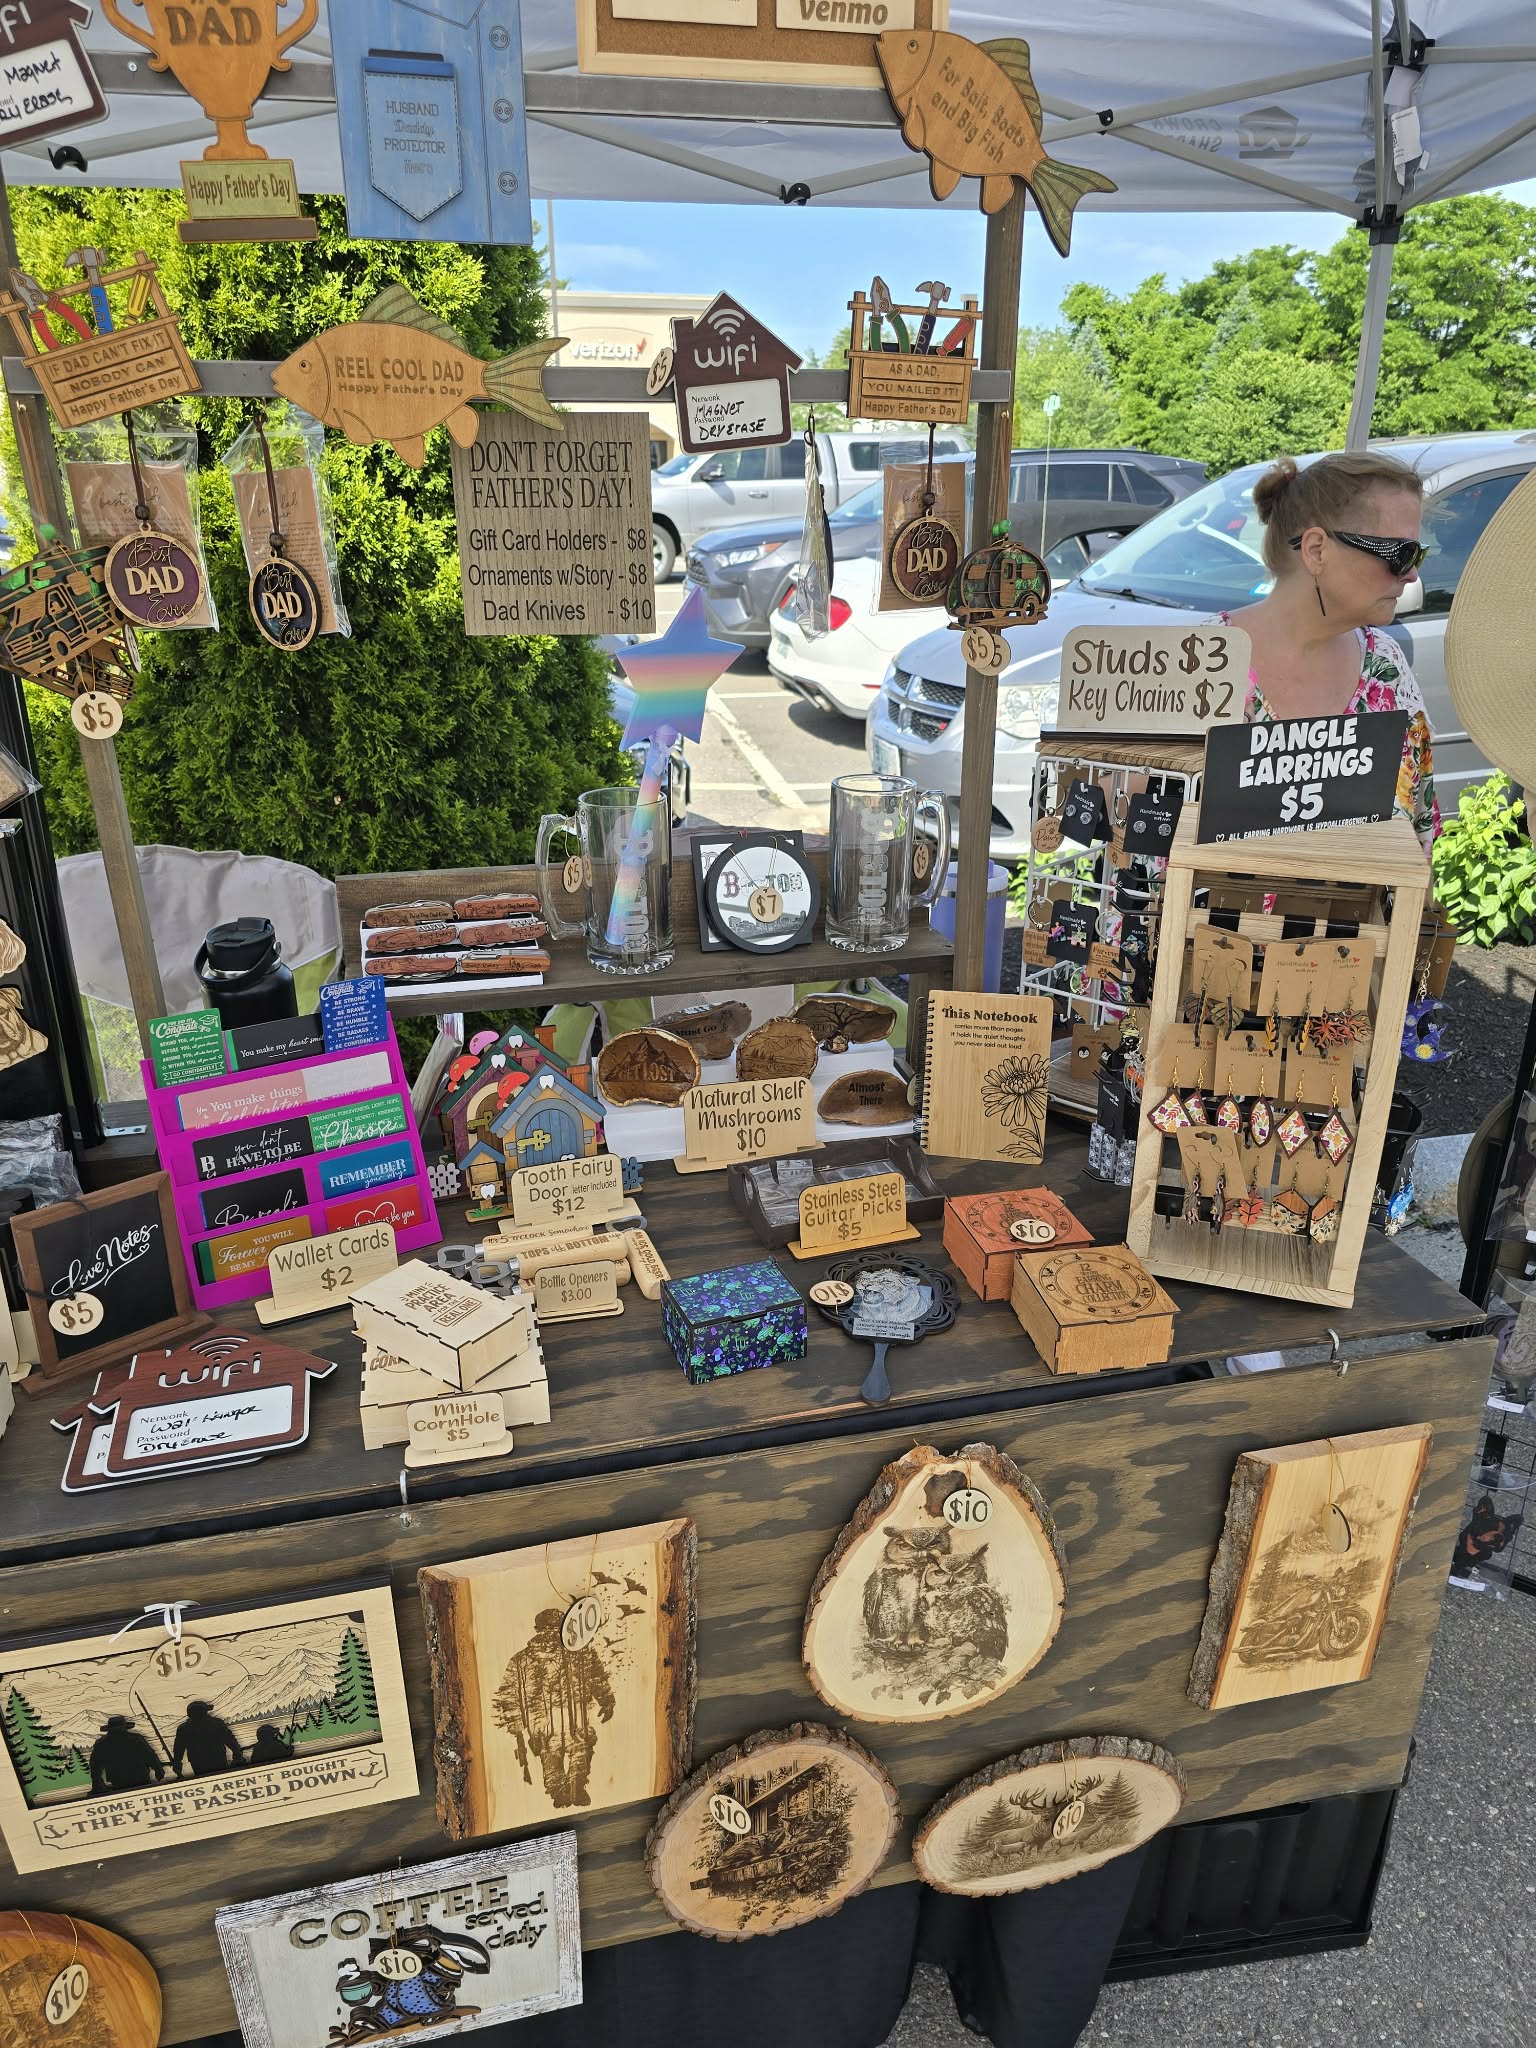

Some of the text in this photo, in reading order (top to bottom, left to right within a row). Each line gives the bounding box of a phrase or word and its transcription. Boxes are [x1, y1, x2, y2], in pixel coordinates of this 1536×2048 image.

[165, 7, 262, 46] DAD
[386, 100, 440, 117] HUSBAND
[937, 56, 1026, 148] For Bait, Boats
[930, 91, 1006, 163] and Big Fish
[384, 137, 446, 154] PROTECTOR
[188, 173, 291, 206] Happy Father's Day
[64, 335, 151, 374] DAD CAN'T FIX
[570, 341, 640, 361] verizon
[69, 356, 167, 393] NOBODY CAN
[335, 356, 464, 382] REEL COOL DAD
[651, 356, 668, 389] $5
[70, 375, 181, 417] Happy Father's Day
[338, 383, 464, 397] Happy Father's Day
[868, 382, 940, 395] YOU NAILED
[865, 400, 957, 417] Happy Father's Day
[470, 441, 633, 473] DON'T FORGET
[472, 477, 634, 508] FATHER'S DAY!
[470, 527, 647, 553] Gift Card Holders $8
[907, 547, 948, 573] DAD
[125, 566, 184, 595] DAD
[468, 562, 647, 591] Ornaments w/Story $8
[262, 591, 303, 619] DAD
[483, 597, 652, 623] Dad Knives $10
[967, 635, 989, 661] $5
[1072, 633, 1230, 676] Studs $3
[1068, 678, 1235, 722] Key Chains $2
[81, 703, 113, 733] $5
[1250, 717, 1359, 756] DANGLE
[1279, 782, 1325, 822] $5
[1228, 831, 1241, 842] ALL
[1272, 825, 1305, 836] HARDWARE
[567, 863, 580, 889] $5
[916, 851, 927, 875] $5
[756, 895, 777, 917] $7
[942, 1005, 1038, 1023] This Notebook
[156, 1019, 199, 1039] Congrats
[240, 1036, 309, 1057] You make my heart
[210, 1085, 304, 1113] You make things
[691, 1080, 806, 1110] Natural Shelf
[848, 1081, 885, 1093] Almost
[858, 1095, 884, 1106] There
[698, 1106, 801, 1130] Mushrooms
[737, 1127, 766, 1151] $10
[226, 1151, 264, 1169] HAVE
[283, 1142, 302, 1156] BE
[330, 1158, 406, 1187] REMEMBER
[518, 1159, 613, 1186] Tooth Fairy
[529, 1178, 617, 1203] Door letter included
[804, 1177, 901, 1211] Stainless Steel
[552, 1196, 585, 1216] $12
[805, 1198, 902, 1227] Guitar Picks
[253, 1229, 294, 1246] YOU WILL
[838, 1222, 862, 1241] $5
[1016, 1224, 1051, 1239] $10
[51, 1224, 158, 1296] Love Notes
[217, 1244, 267, 1265] Forever
[275, 1229, 390, 1273] Wallet Cards
[520, 1235, 609, 1260] TOPS BOTTOM
[321, 1265, 354, 1292] $2
[540, 1271, 609, 1289] Bottle Openers
[1076, 1273, 1112, 1284] EARRING
[1076, 1280, 1123, 1295] CHARM
[405, 1283, 451, 1311] PRACTICE
[423, 1292, 456, 1313] AREA
[561, 1287, 592, 1303] $3.00
[1082, 1290, 1132, 1304] COLLECTION
[60, 1301, 94, 1330] $5
[414, 1411, 500, 1432] CornHole
[434, 1401, 477, 1417] Mini
[447, 1429, 470, 1442] $5
[949, 1497, 989, 1523] $10
[567, 1603, 600, 1647] $10
[155, 1644, 202, 1680] $15
[86, 1759, 348, 1817] SOME THINGS AREN'T BOUGHT
[72, 1768, 357, 1835] THEY'RE PASSED DOWN
[714, 1803, 748, 1830] $10
[1056, 1804, 1083, 1836] $10
[289, 1875, 510, 1949] COFFEE
[465, 1891, 548, 1930] served
[486, 1920, 547, 1949] daily
[380, 1956, 418, 1976] $10
[51, 1972, 88, 2022] $10
